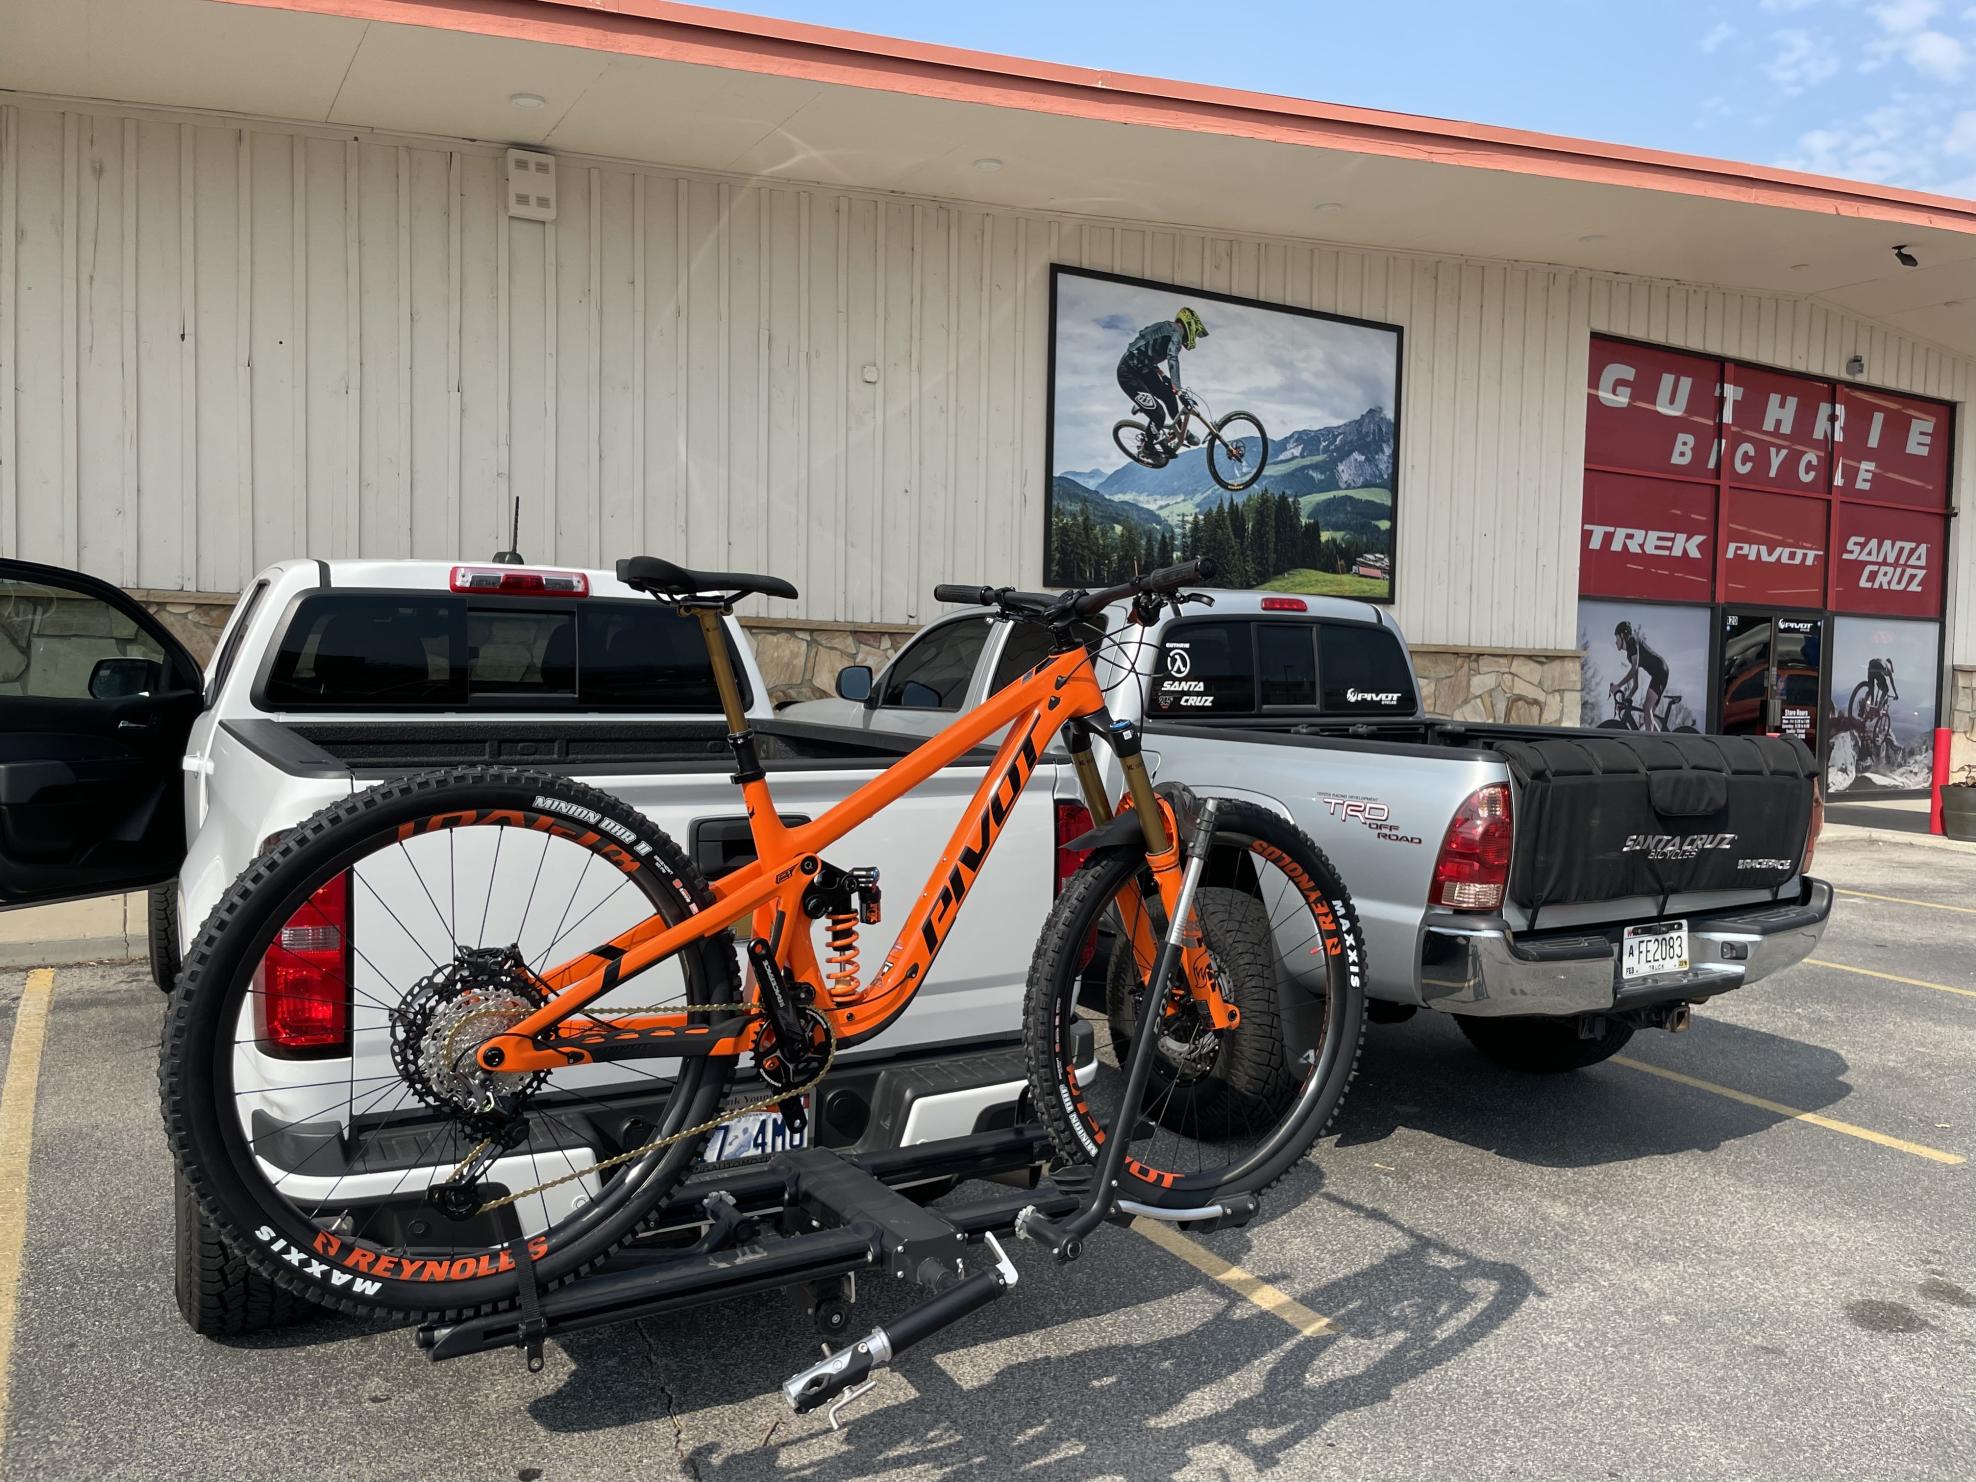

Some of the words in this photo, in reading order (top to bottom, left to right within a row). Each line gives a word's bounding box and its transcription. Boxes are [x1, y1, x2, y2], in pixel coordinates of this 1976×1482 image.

[1599, 363, 1935, 456] GUTHRIE
[1670, 432, 1876, 490] BICYCLE
[1584, 524, 1708, 559] TREK
[1726, 542, 1823, 566] PIVOT
[1842, 536, 1927, 566] SANTA
[1858, 564, 1928, 592] CRUZ
[1161, 681, 1204, 691] SANTA
[1180, 696, 1214, 706] CRUZ
[1357, 693, 1402, 701] PIVOT
[532, 796, 601, 824] MINION
[599, 817, 637, 844] DHR
[634, 841, 653, 856] II
[1323, 797, 1389, 825] TRD
[920, 713, 1040, 956] PIVOT
[1368, 821, 1400, 832] OFF
[1377, 832, 1422, 844] ROAD
[1622, 834, 1681, 851] SANTA
[1681, 833, 1736, 850] CRUZ
[1648, 849, 1699, 860] BICYCLES
[1250, 839, 1337, 932] REYNOLDS
[1332, 900, 1361, 988] MAXXIS
[1628, 944, 1635, 958] A
[1637, 935, 1683, 965] FE2083
[255, 1224, 382, 1296] MAXXIS
[343, 1236, 549, 1282] REYNOLS
